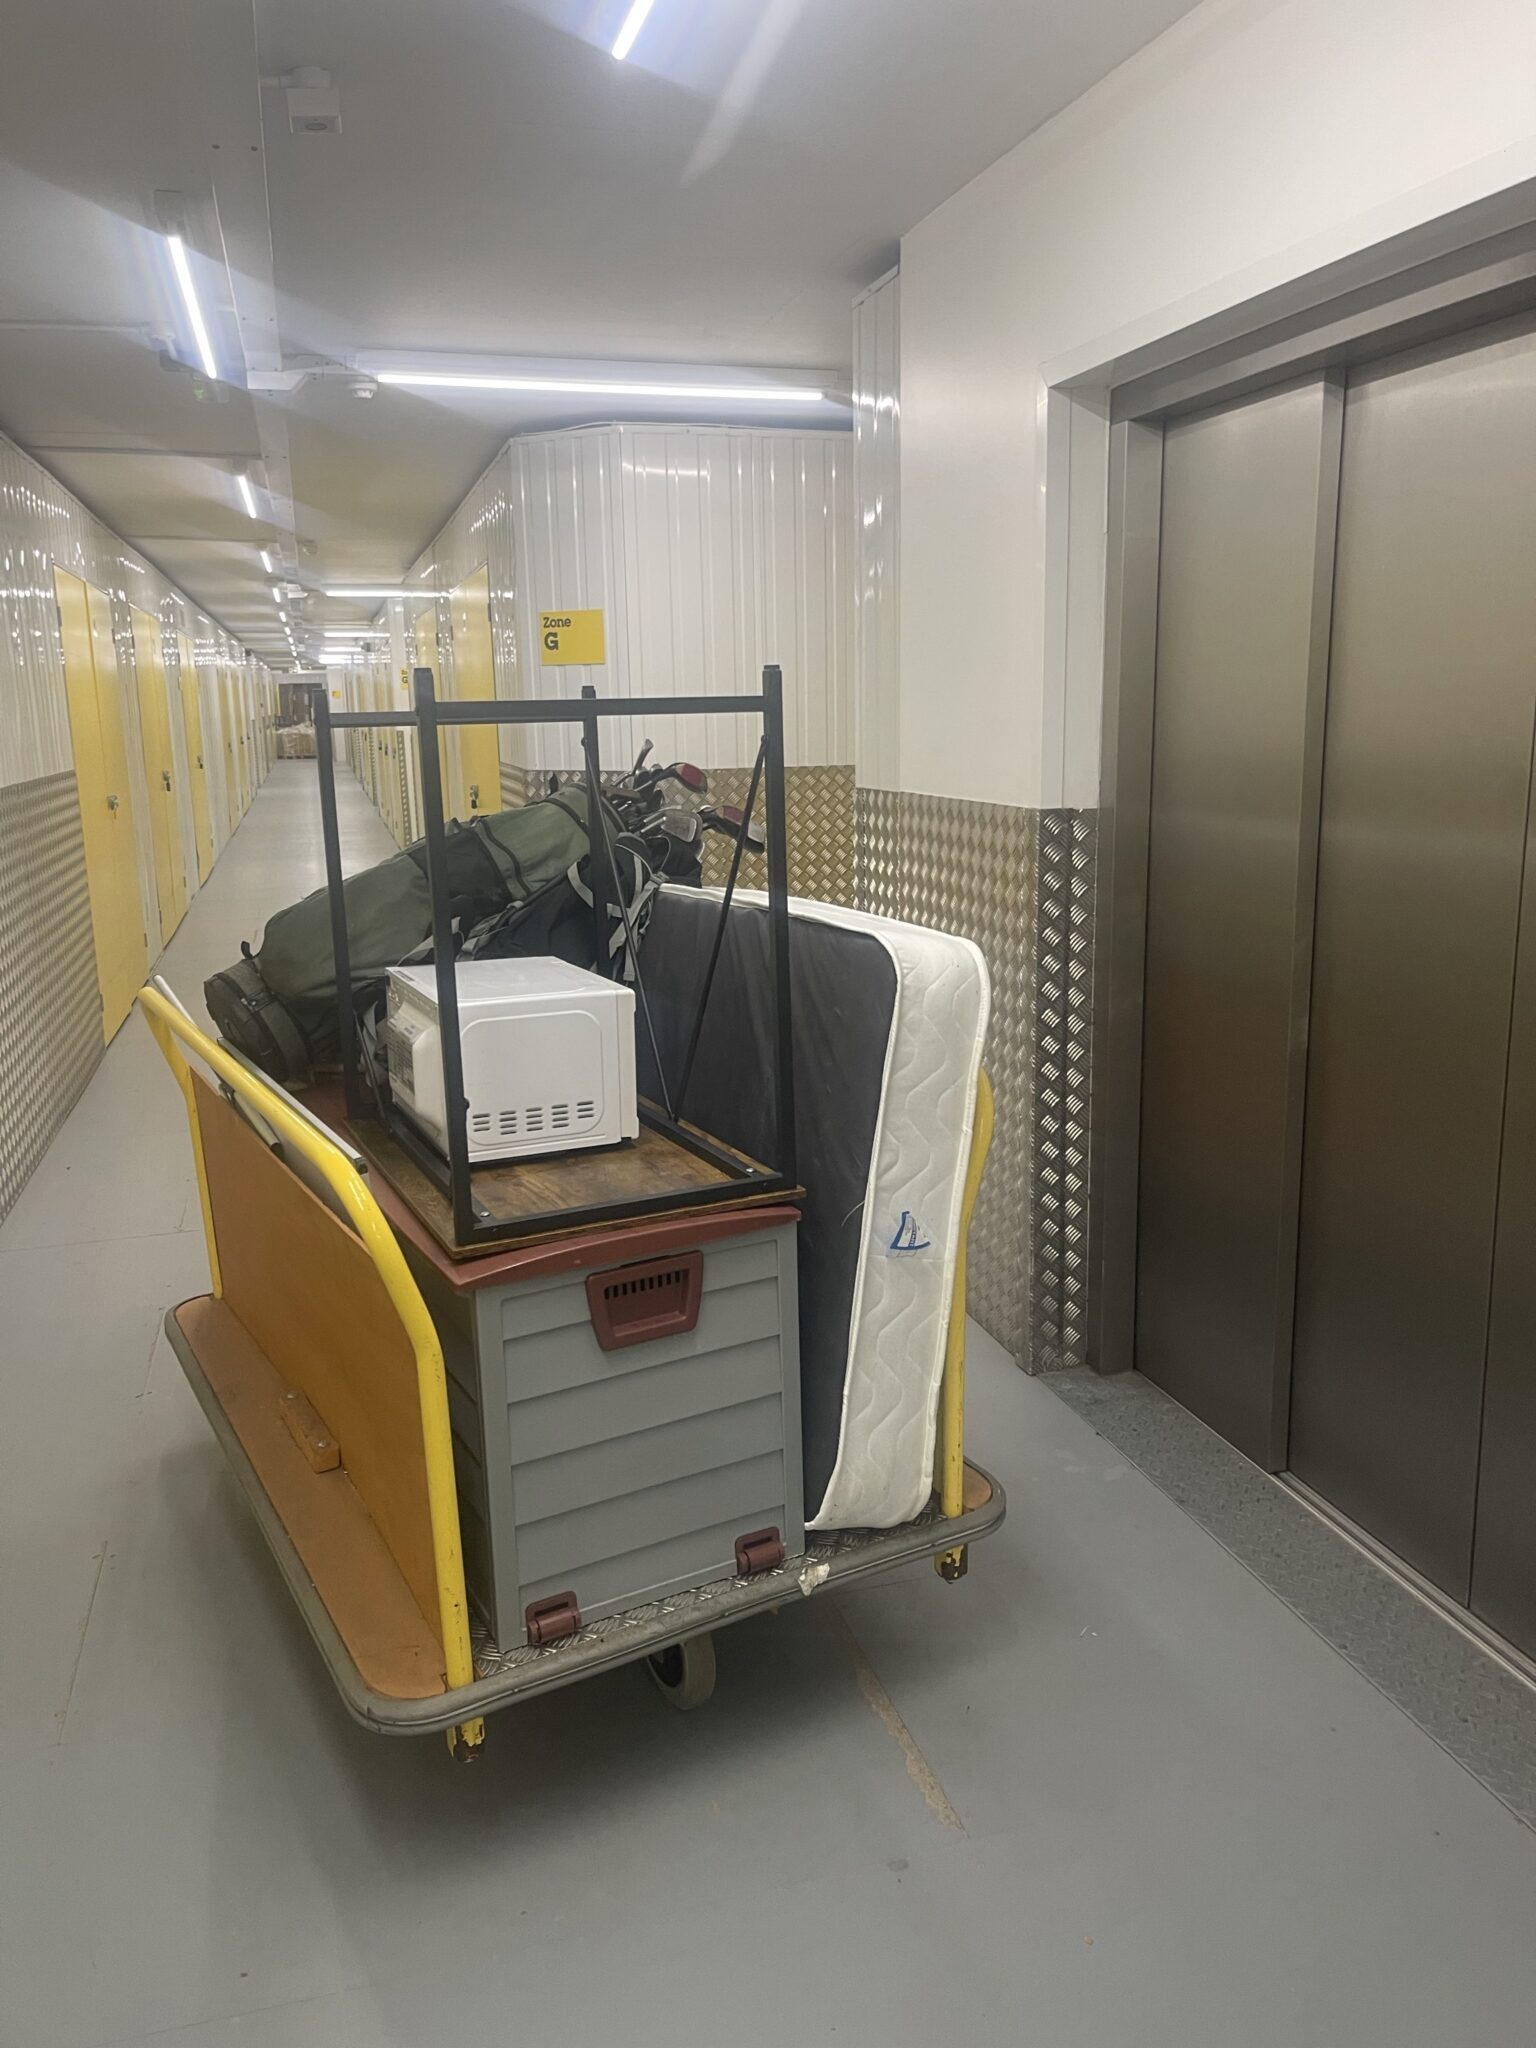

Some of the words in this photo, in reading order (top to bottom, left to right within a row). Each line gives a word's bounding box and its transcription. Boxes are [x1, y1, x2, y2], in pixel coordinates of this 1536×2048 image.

[543, 616, 572, 628] Zone
[544, 632, 559, 650] G
[402, 676, 408, 684] G
